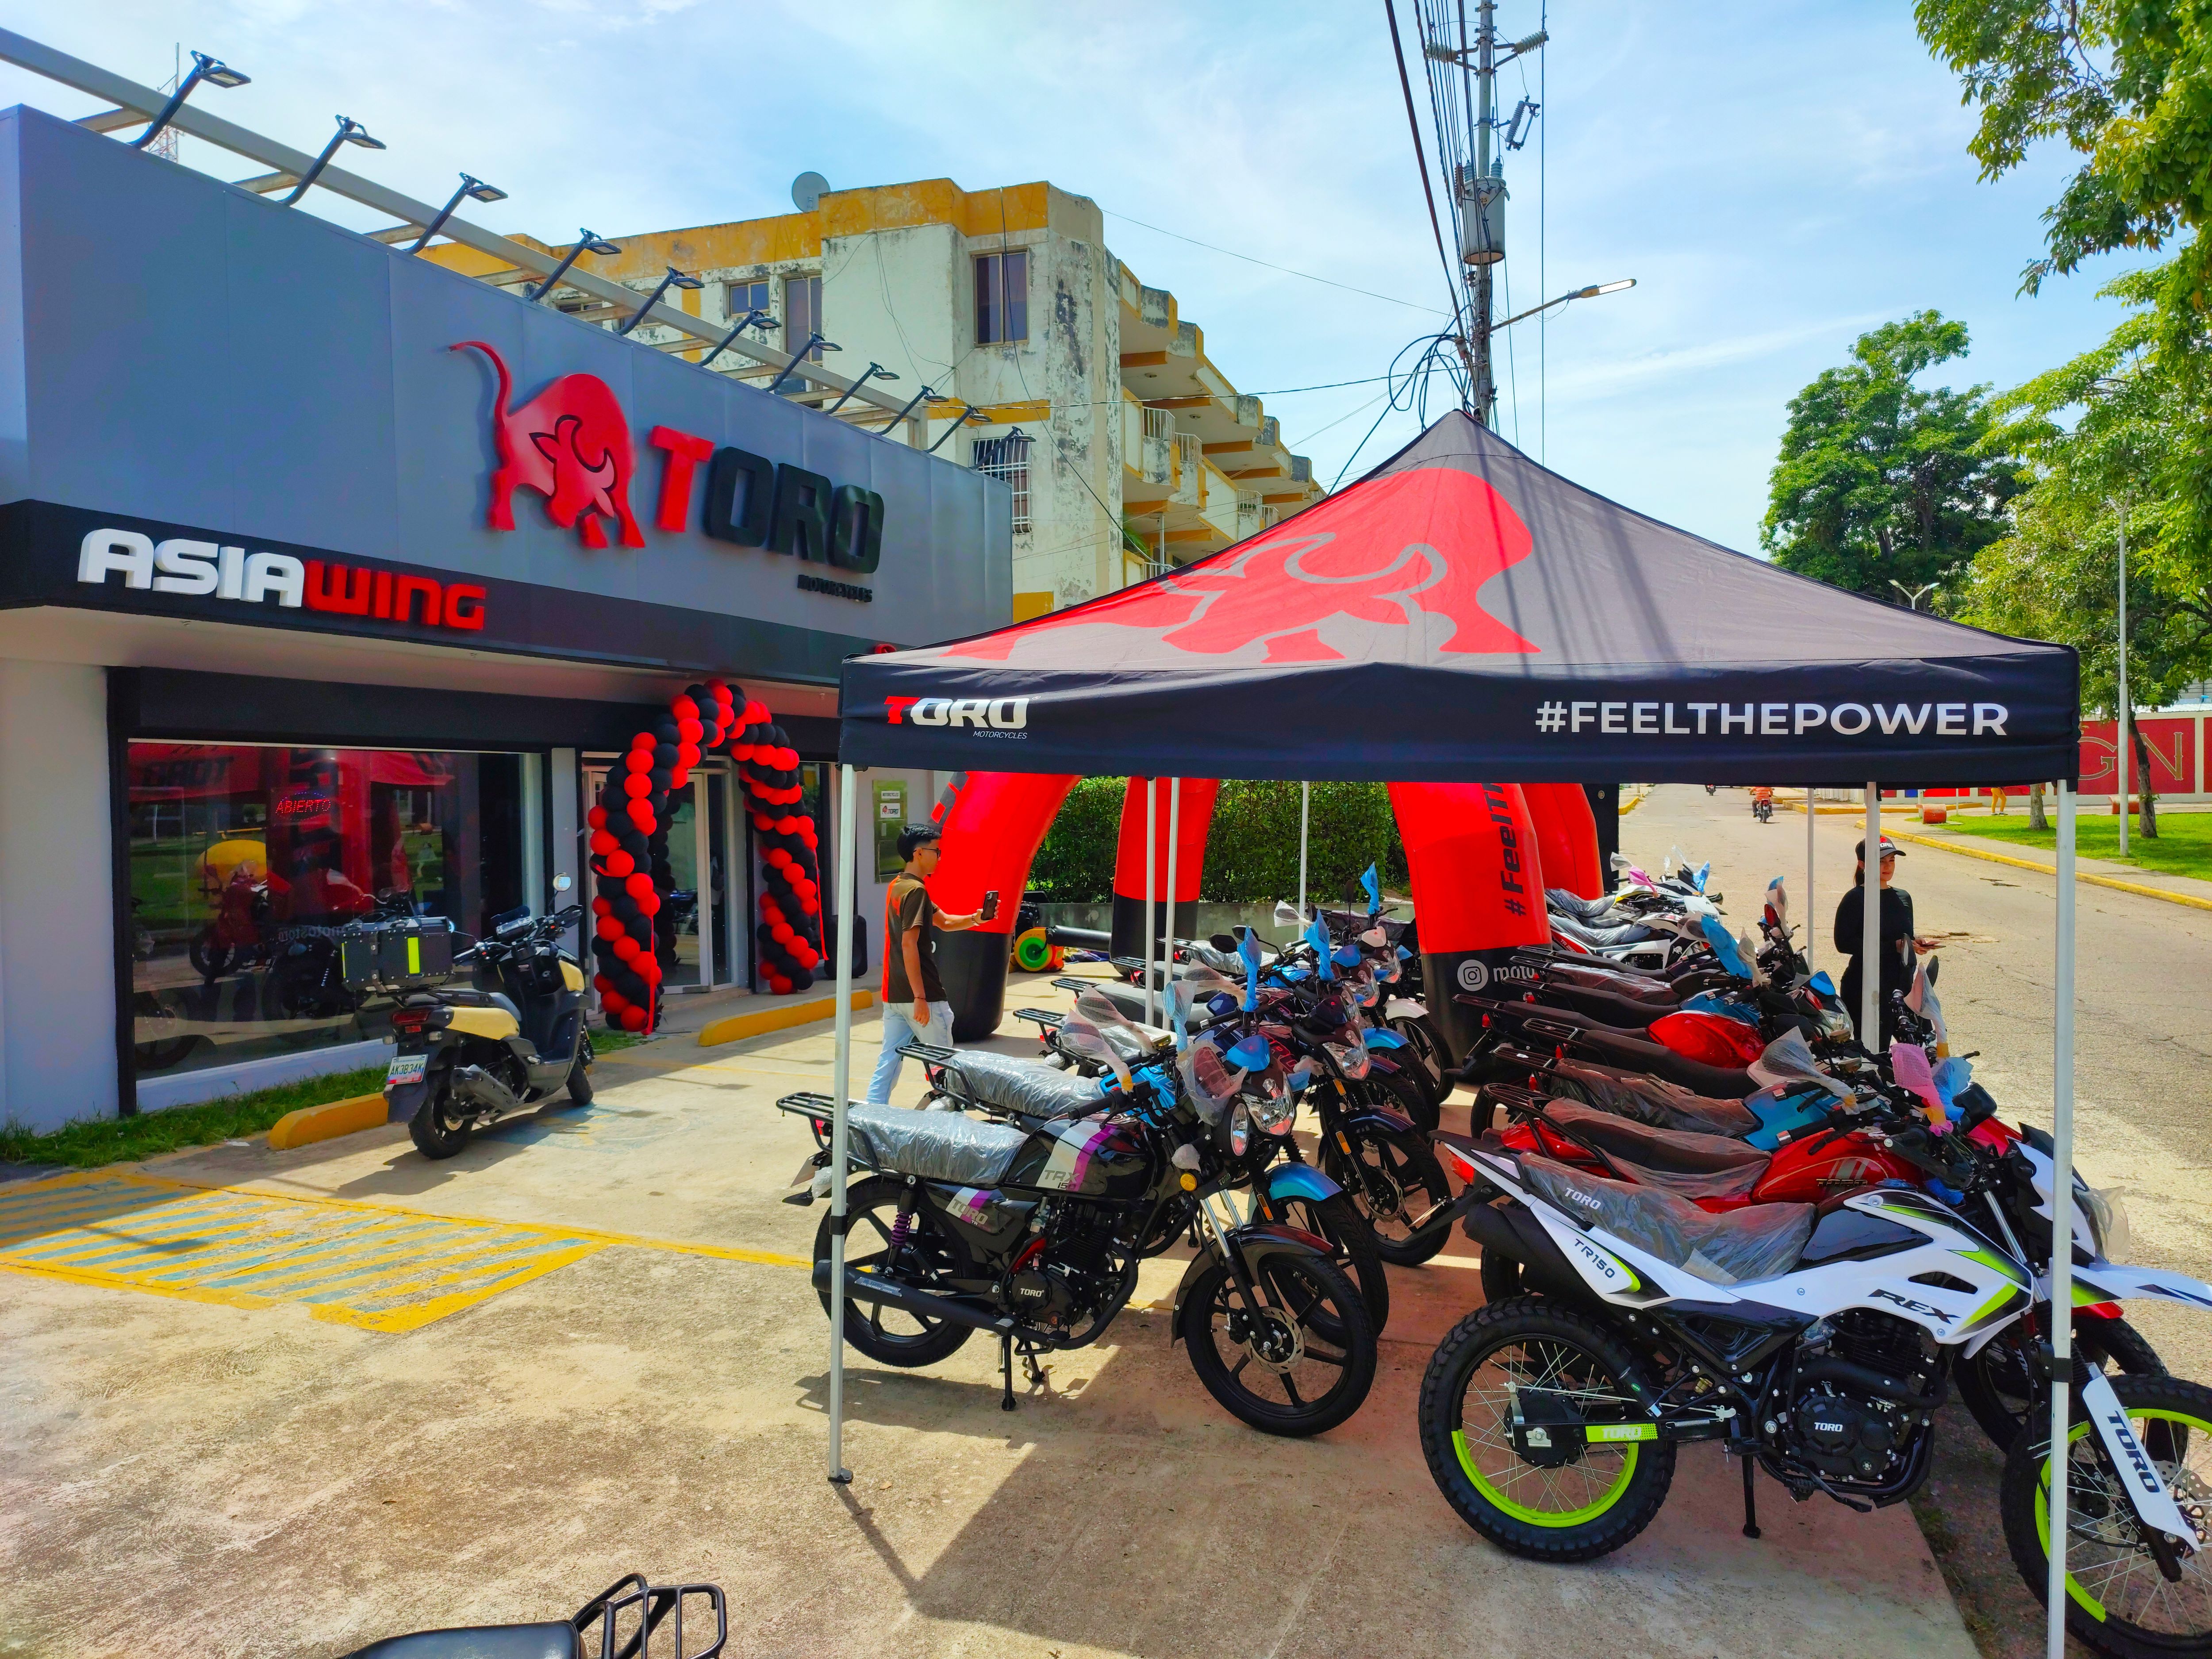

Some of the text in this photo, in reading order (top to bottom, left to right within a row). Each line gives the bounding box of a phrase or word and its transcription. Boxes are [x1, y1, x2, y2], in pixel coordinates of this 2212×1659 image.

[647, 425, 885, 574] TORO
[797, 574, 873, 603] MOTORCYCLES
[884, 695, 1029, 729] TORO
[1535, 701, 2008, 736] #FEELTHEPOWER
[973, 730, 1028, 739] MOTORCYCLES
[275, 799, 331, 814] ABIERTO
[1045, 1169, 1080, 1183] TRX
[952, 1198, 988, 1225] TORO
[1564, 1187, 1601, 1210] TORO
[1574, 1238, 1615, 1278] TR150
[1020, 1288, 1042, 1297] TORO
[1867, 1288, 1962, 1325] REX
[1601, 1427, 1642, 1439] TORO
[1814, 1422, 1843, 1432] TORO
[2107, 1410, 2160, 1493] TORO
